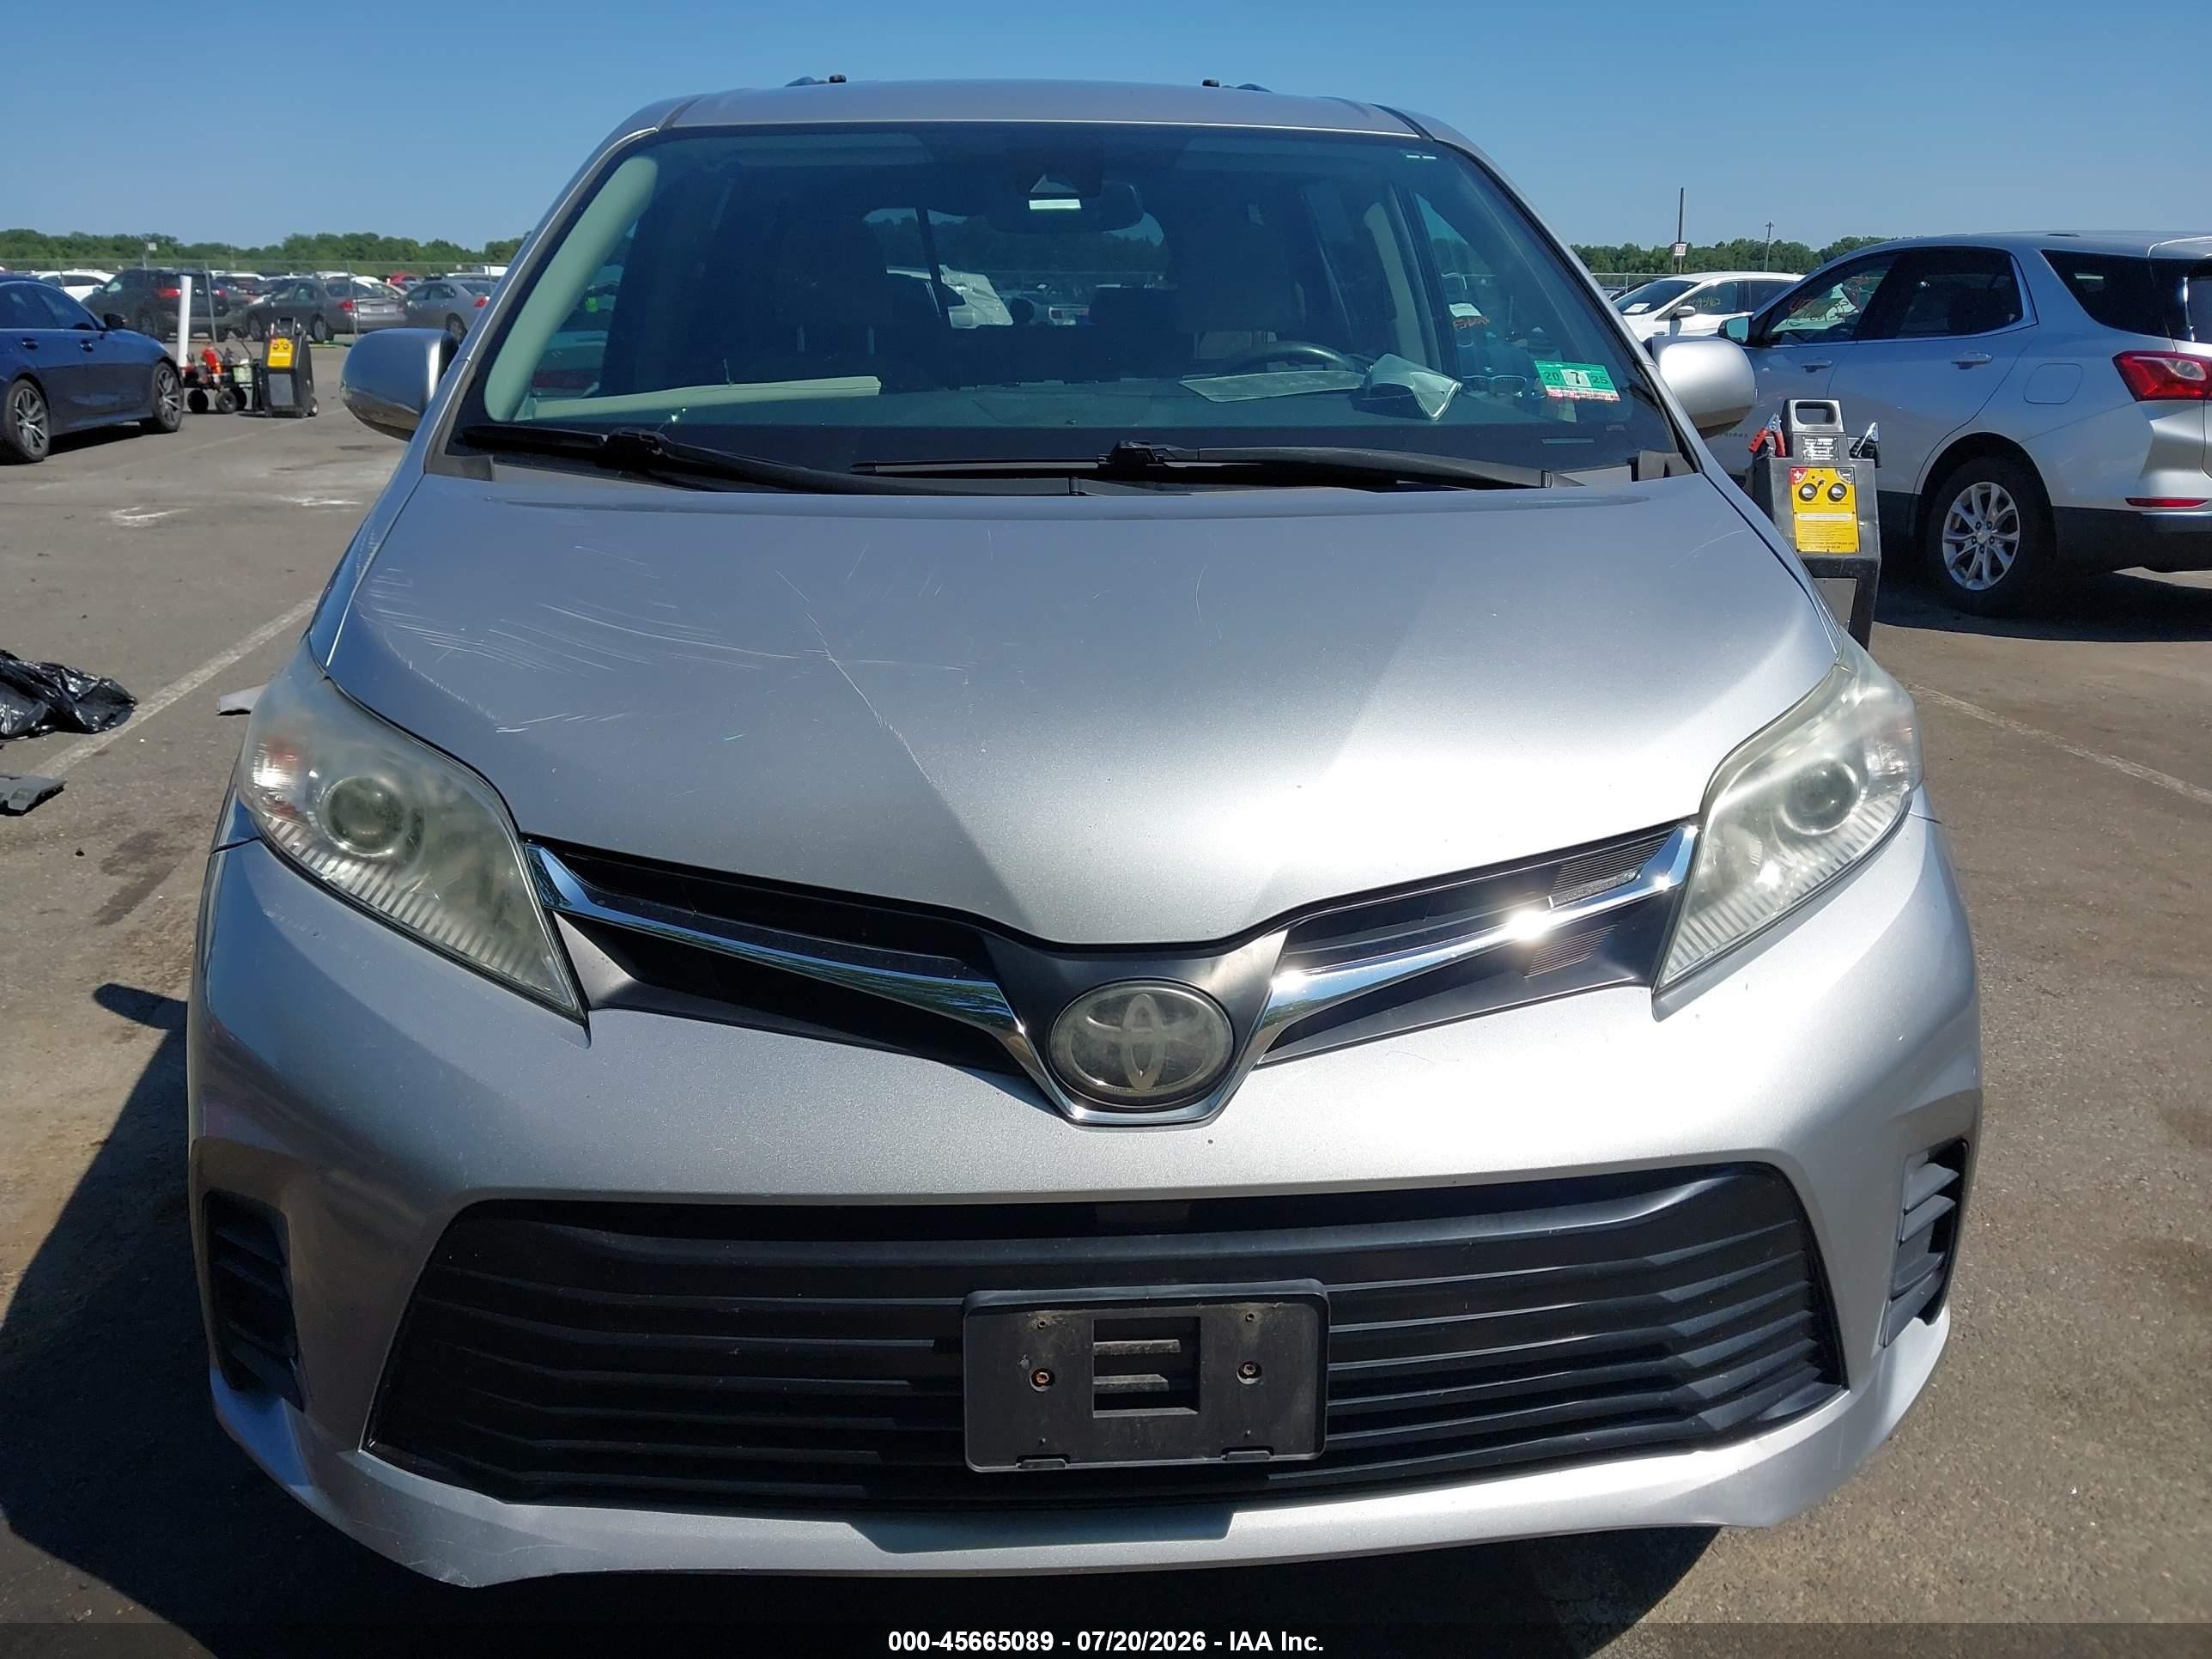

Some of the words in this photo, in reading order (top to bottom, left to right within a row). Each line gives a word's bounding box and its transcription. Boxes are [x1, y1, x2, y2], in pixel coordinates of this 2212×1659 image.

[1543, 371, 1560, 381] 20
[1570, 371, 1581, 385] 7
[1590, 375, 1608, 385] 25
